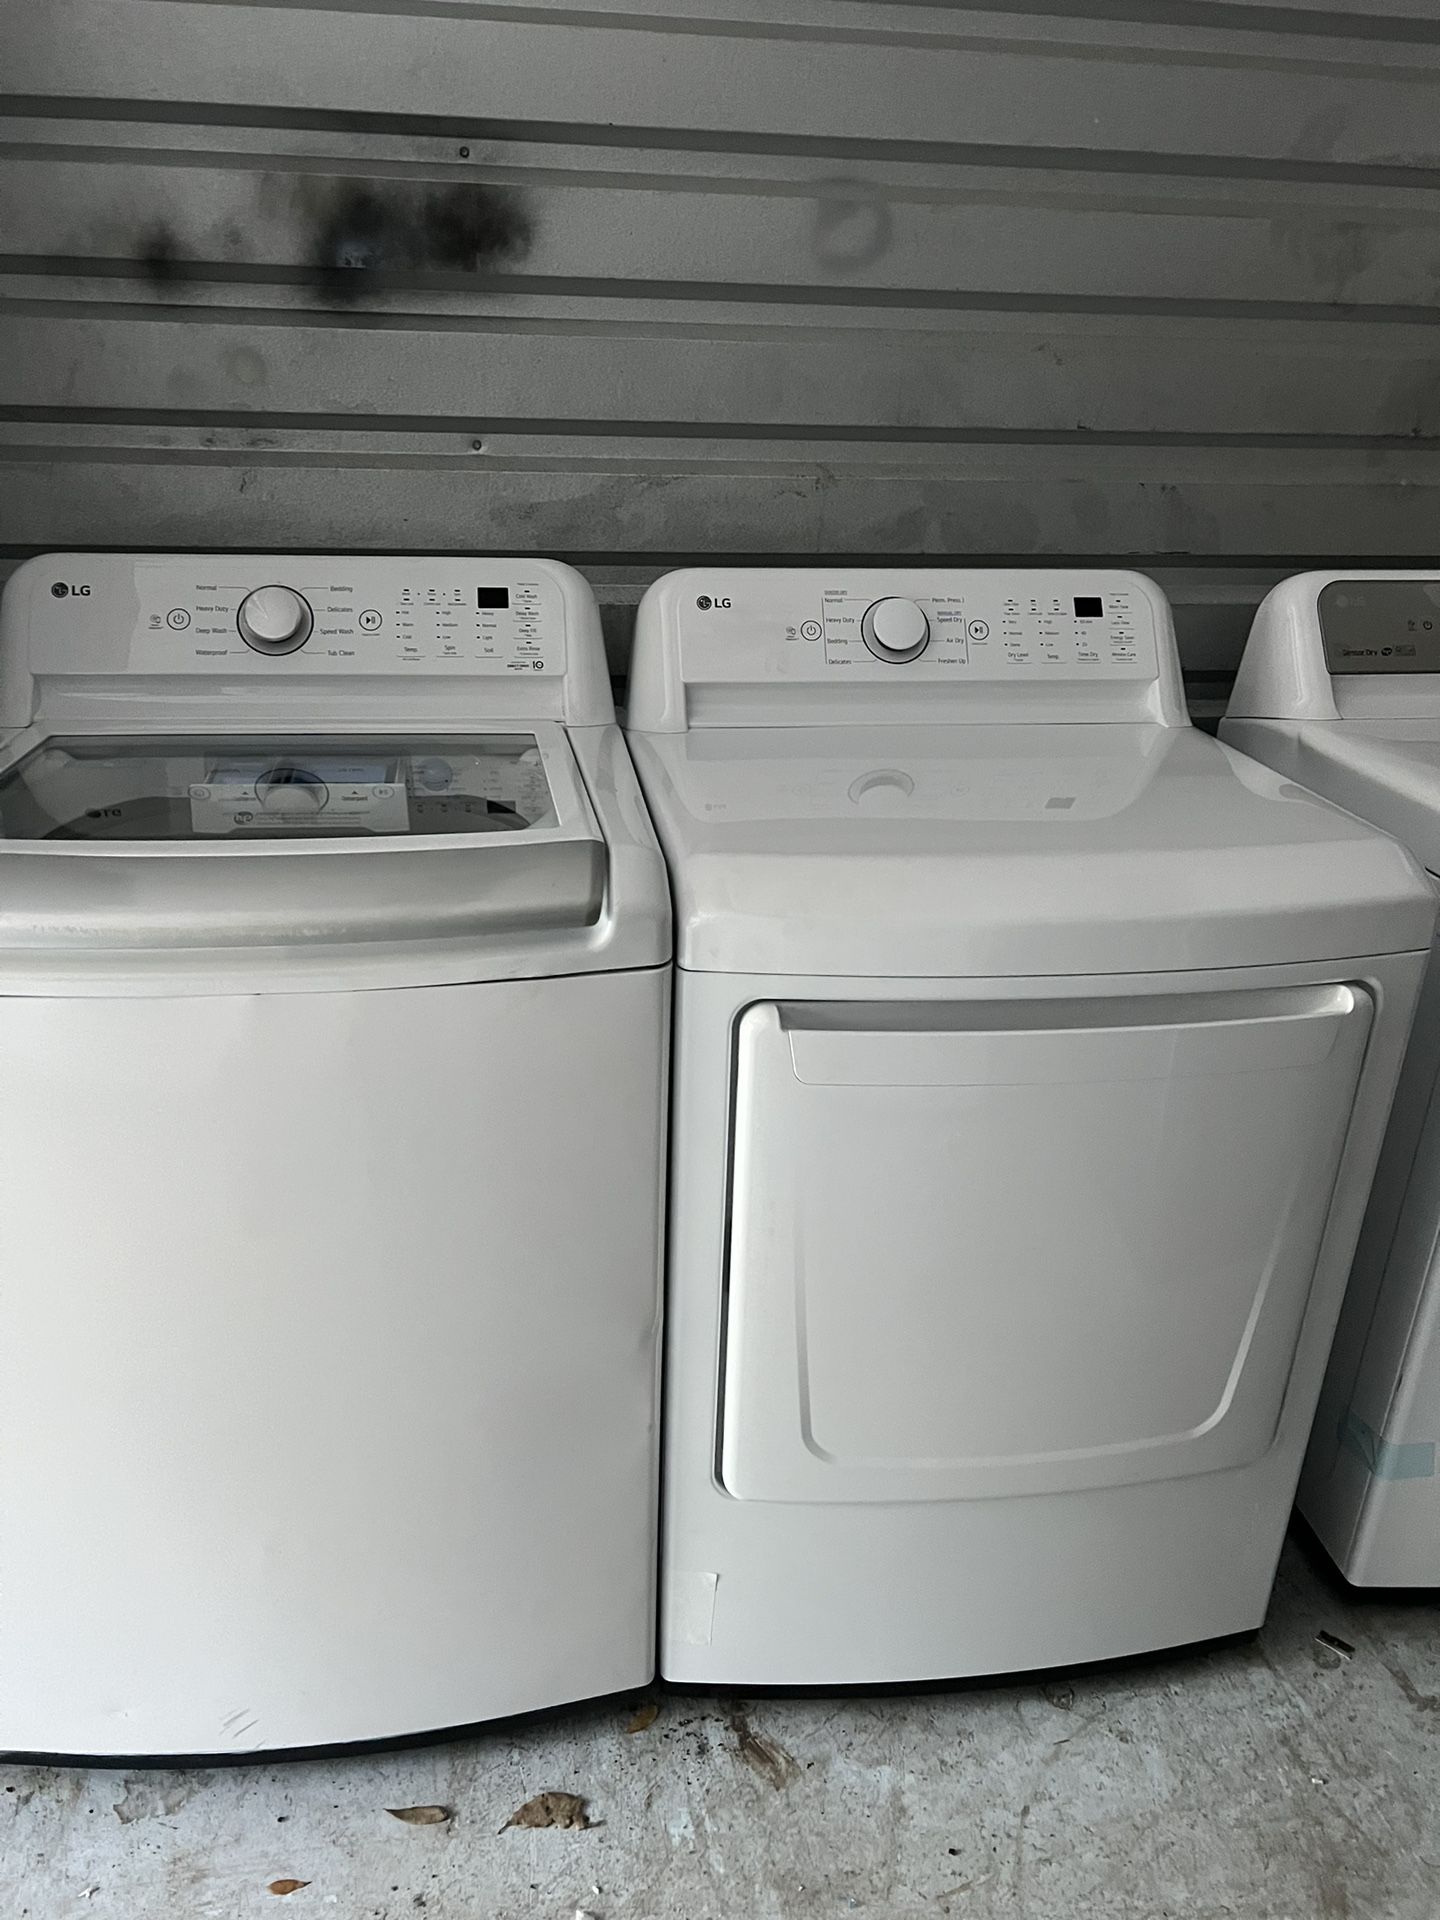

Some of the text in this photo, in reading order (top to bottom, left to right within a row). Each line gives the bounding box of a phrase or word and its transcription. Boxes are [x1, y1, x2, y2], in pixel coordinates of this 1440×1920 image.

[72, 585, 91, 596] LG
[330, 585, 353, 593] Bedding
[714, 598, 731, 608] LG
[215, 605, 229, 613] Duty
[320, 628, 337, 636] Speed
